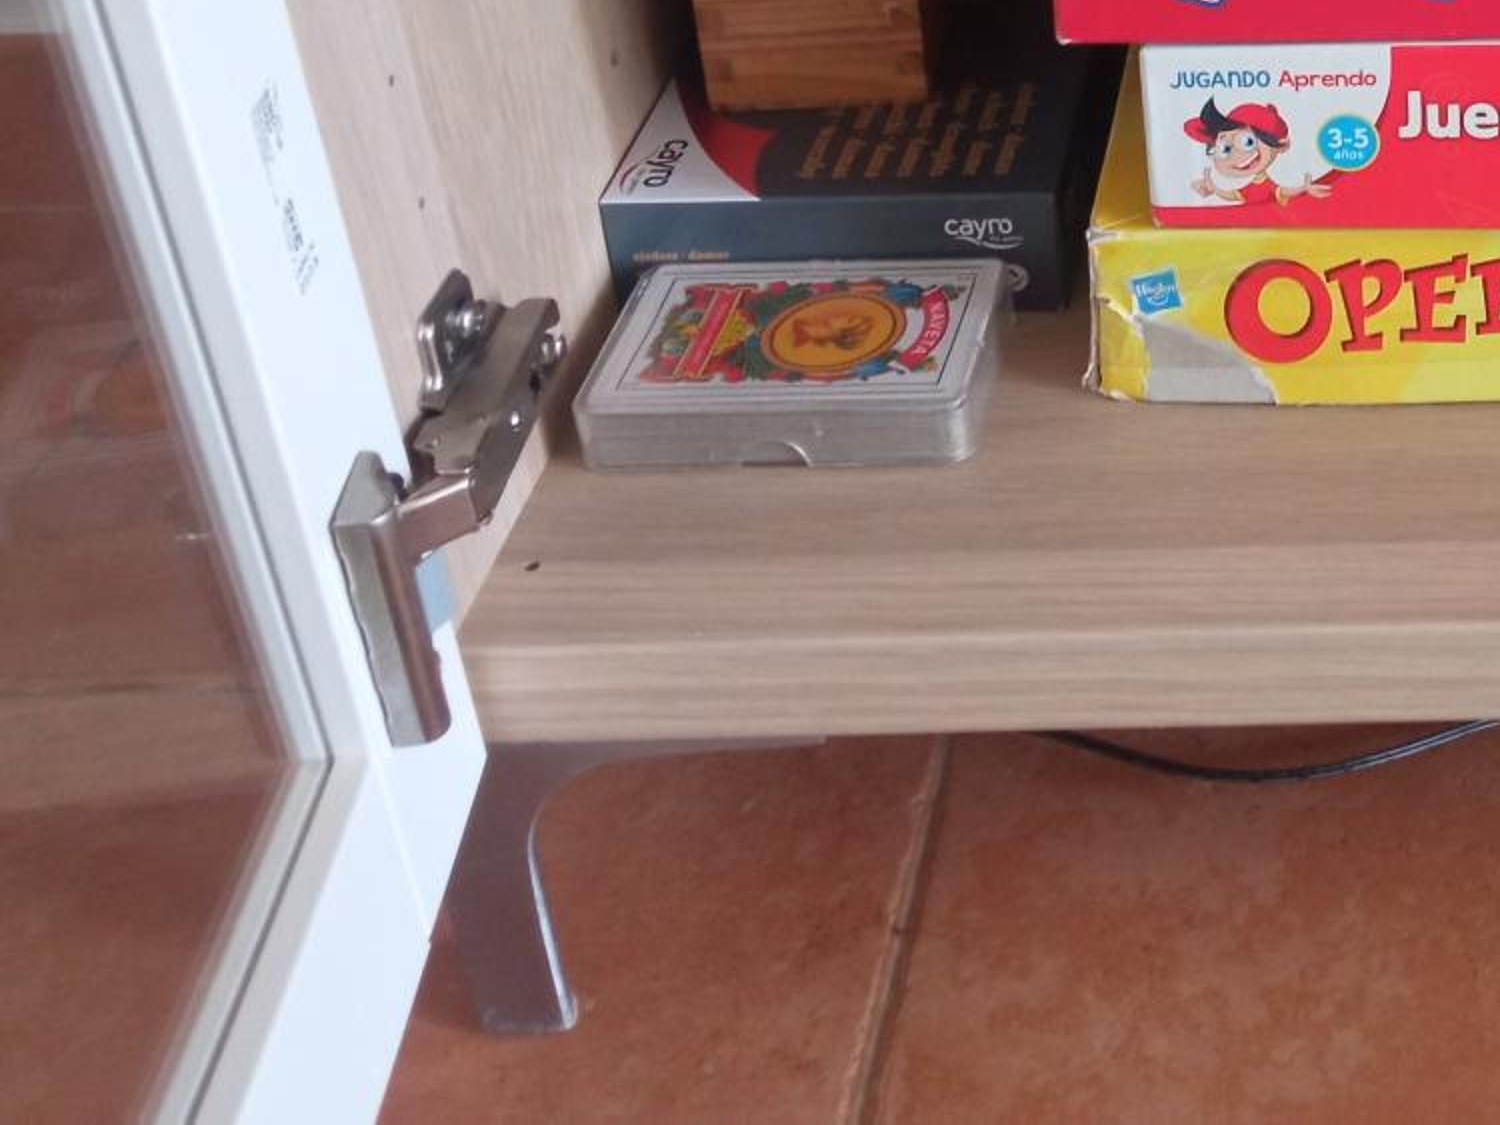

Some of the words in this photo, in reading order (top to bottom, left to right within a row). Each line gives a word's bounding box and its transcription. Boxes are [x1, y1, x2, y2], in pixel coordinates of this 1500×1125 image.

[1169, 69, 1272, 91] JUGANDO
[1278, 68, 1378, 92] Aprendo
[1327, 127, 1370, 149] 3-5
[643, 139, 689, 188] cayro
[1333, 148, 1365, 160] años
[943, 218, 1013, 241] cayro
